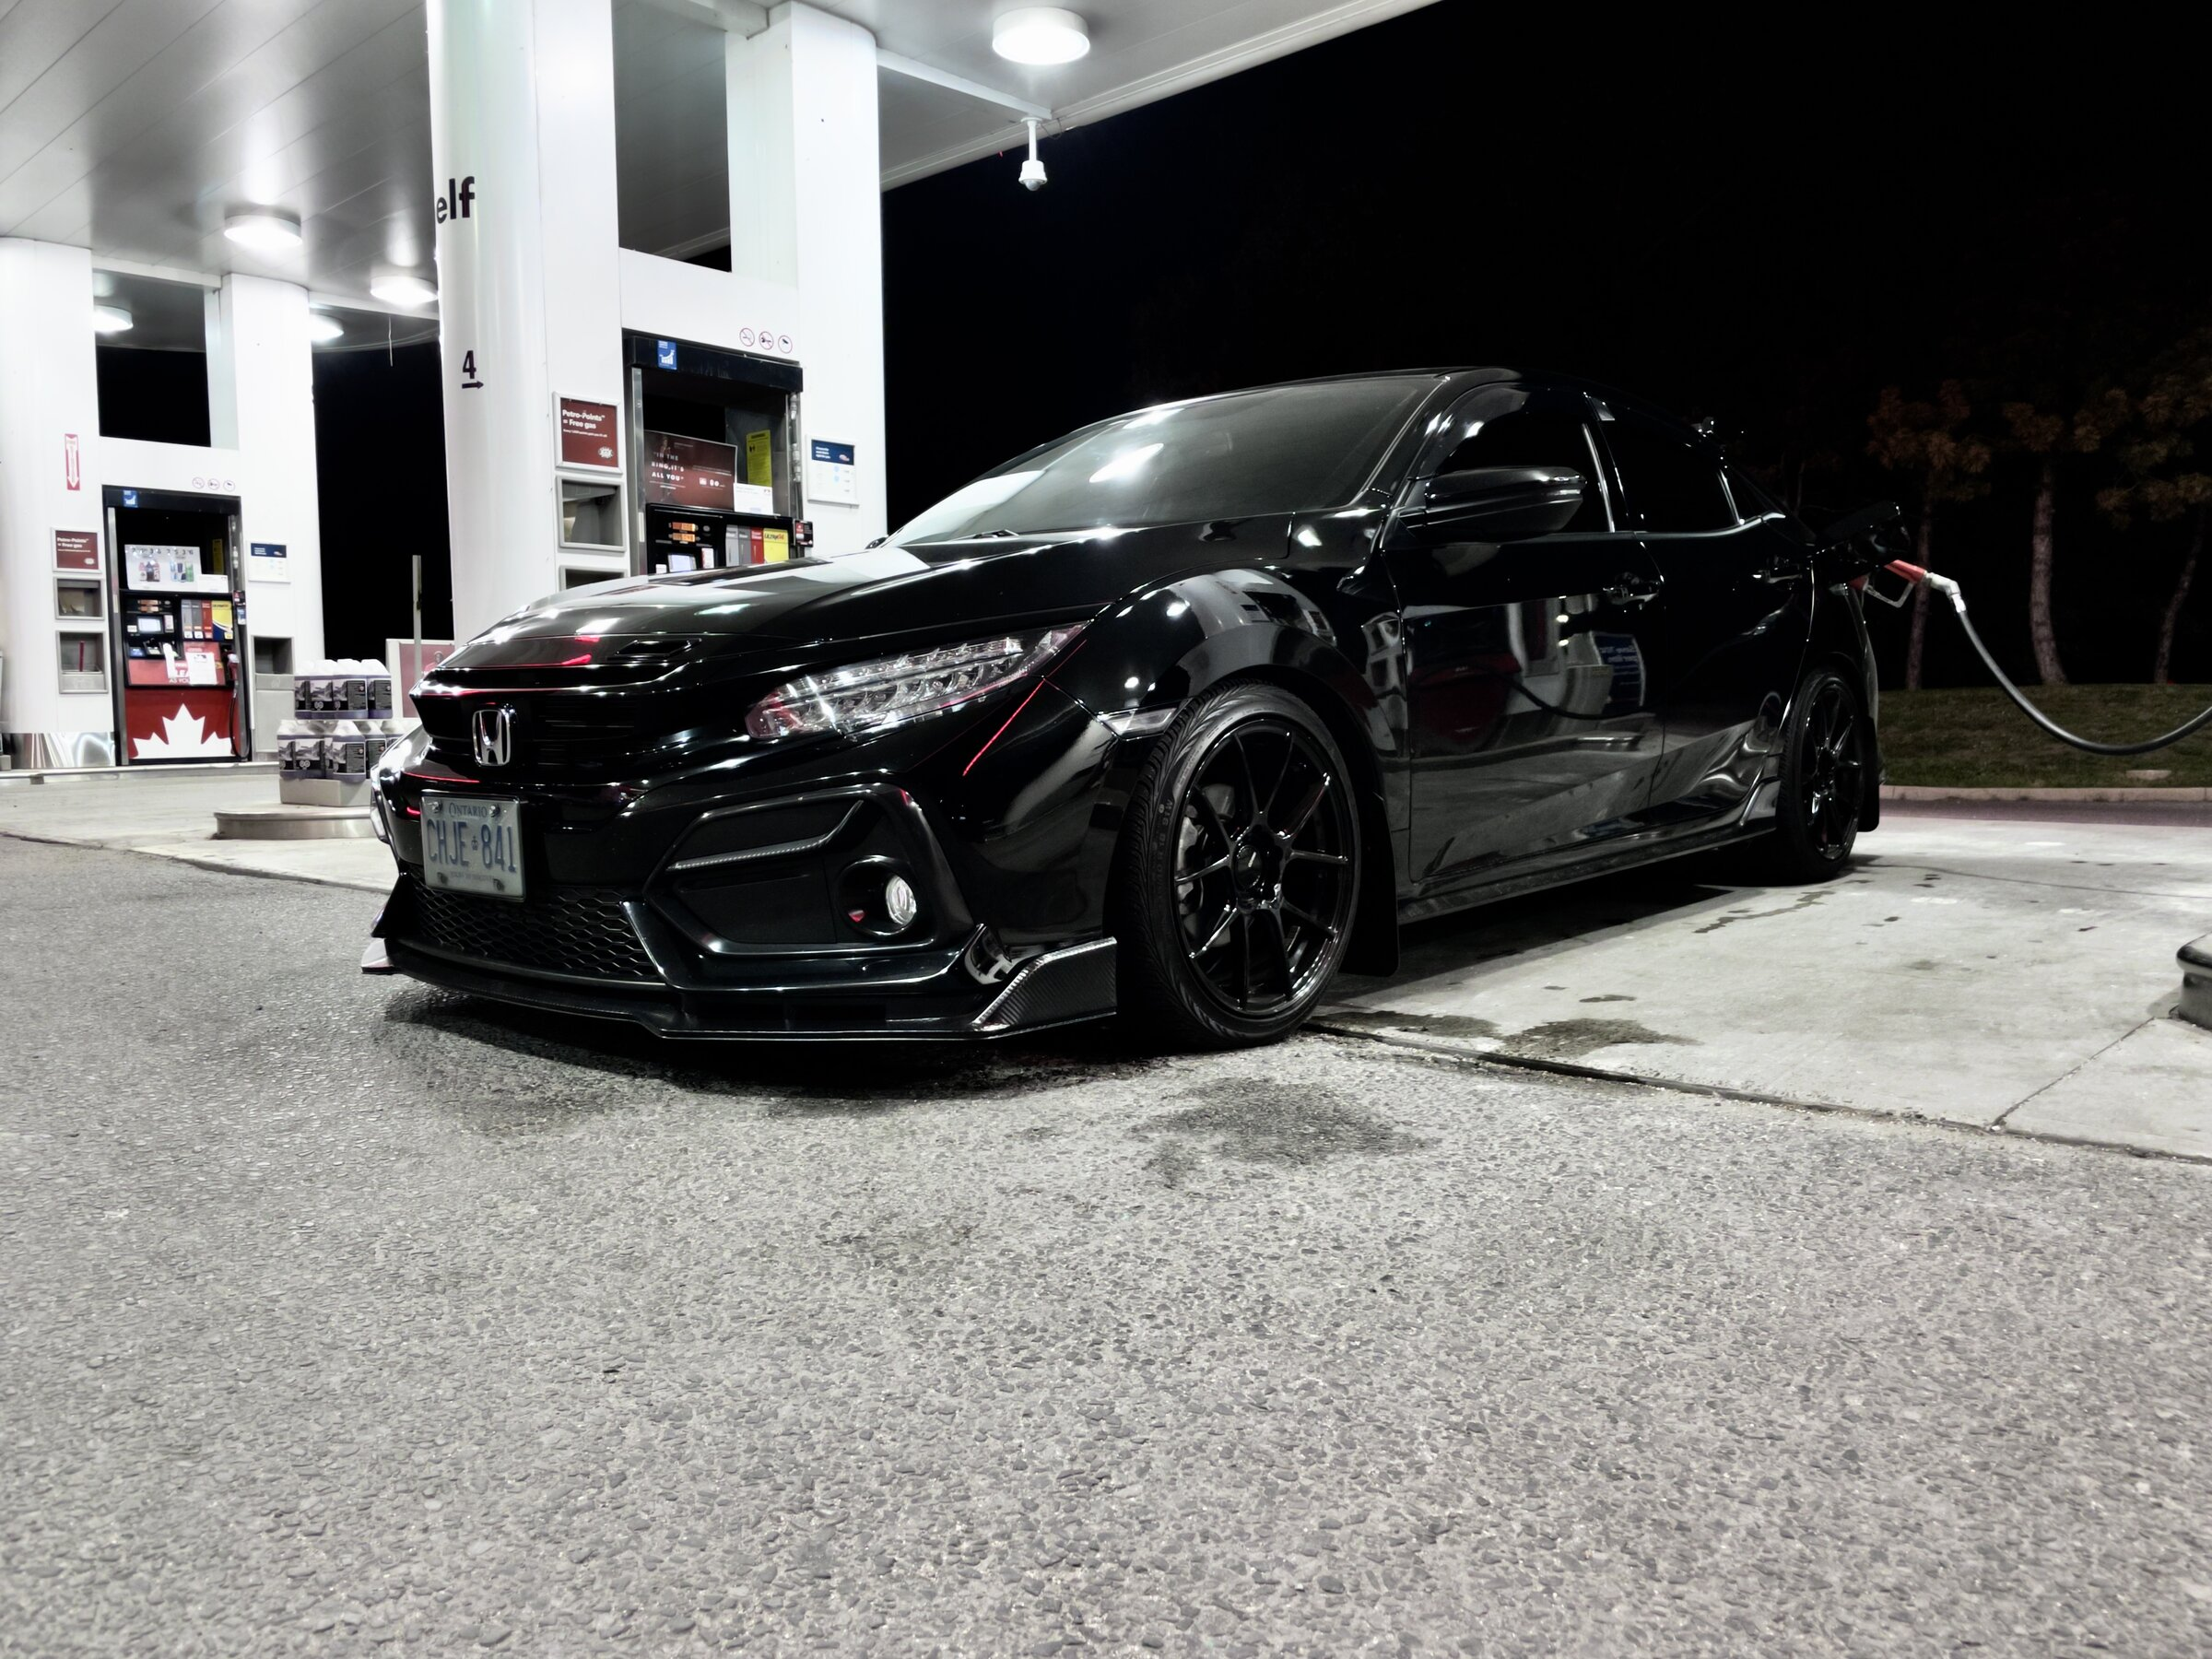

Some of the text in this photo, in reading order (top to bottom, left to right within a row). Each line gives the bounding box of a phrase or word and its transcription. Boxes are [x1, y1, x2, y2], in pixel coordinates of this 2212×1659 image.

[462, 350, 477, 380] 4
[569, 418, 583, 428] Free
[652, 471, 665, 479] ALL
[448, 802, 488, 818] ONTARIO
[426, 818, 517, 875] CHJE 841
